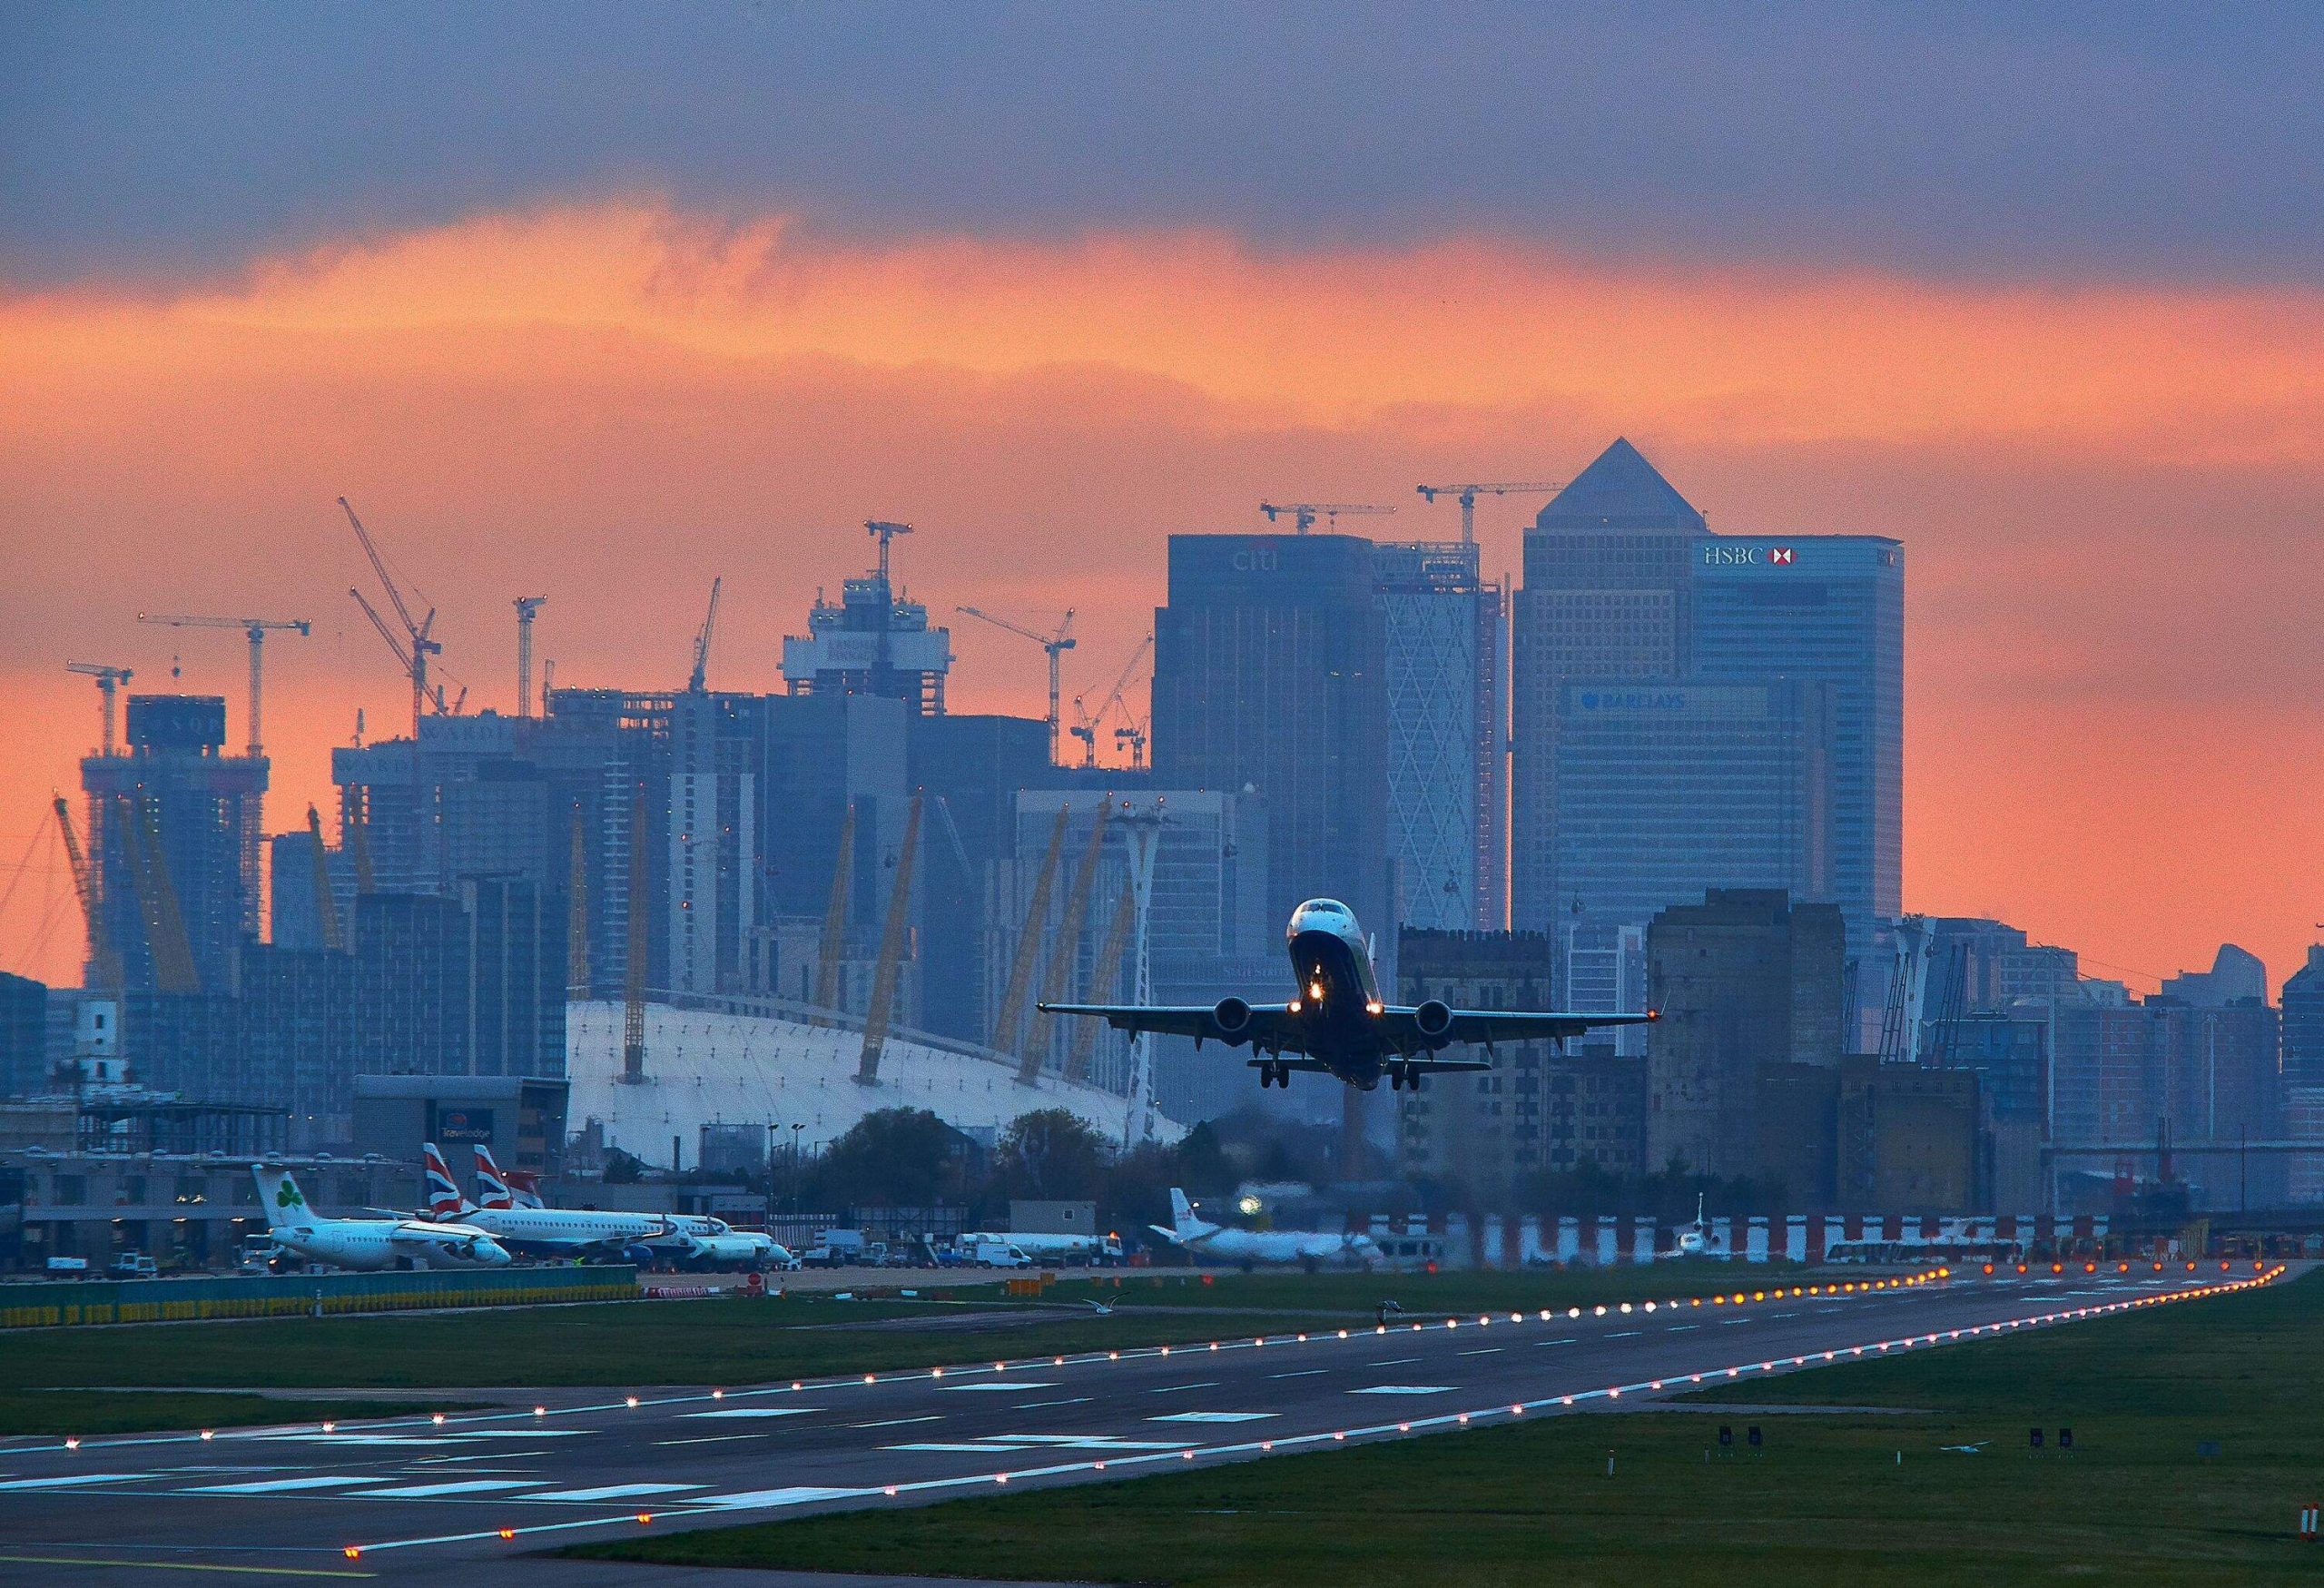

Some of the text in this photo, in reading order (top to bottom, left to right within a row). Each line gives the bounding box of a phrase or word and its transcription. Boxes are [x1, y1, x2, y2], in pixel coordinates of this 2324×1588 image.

[1233, 546, 1278, 571] citi
[1704, 547, 1763, 564] HSBC
[1602, 694, 1686, 709] BARCLAYS
[441, 1127, 490, 1139] Travelodge
